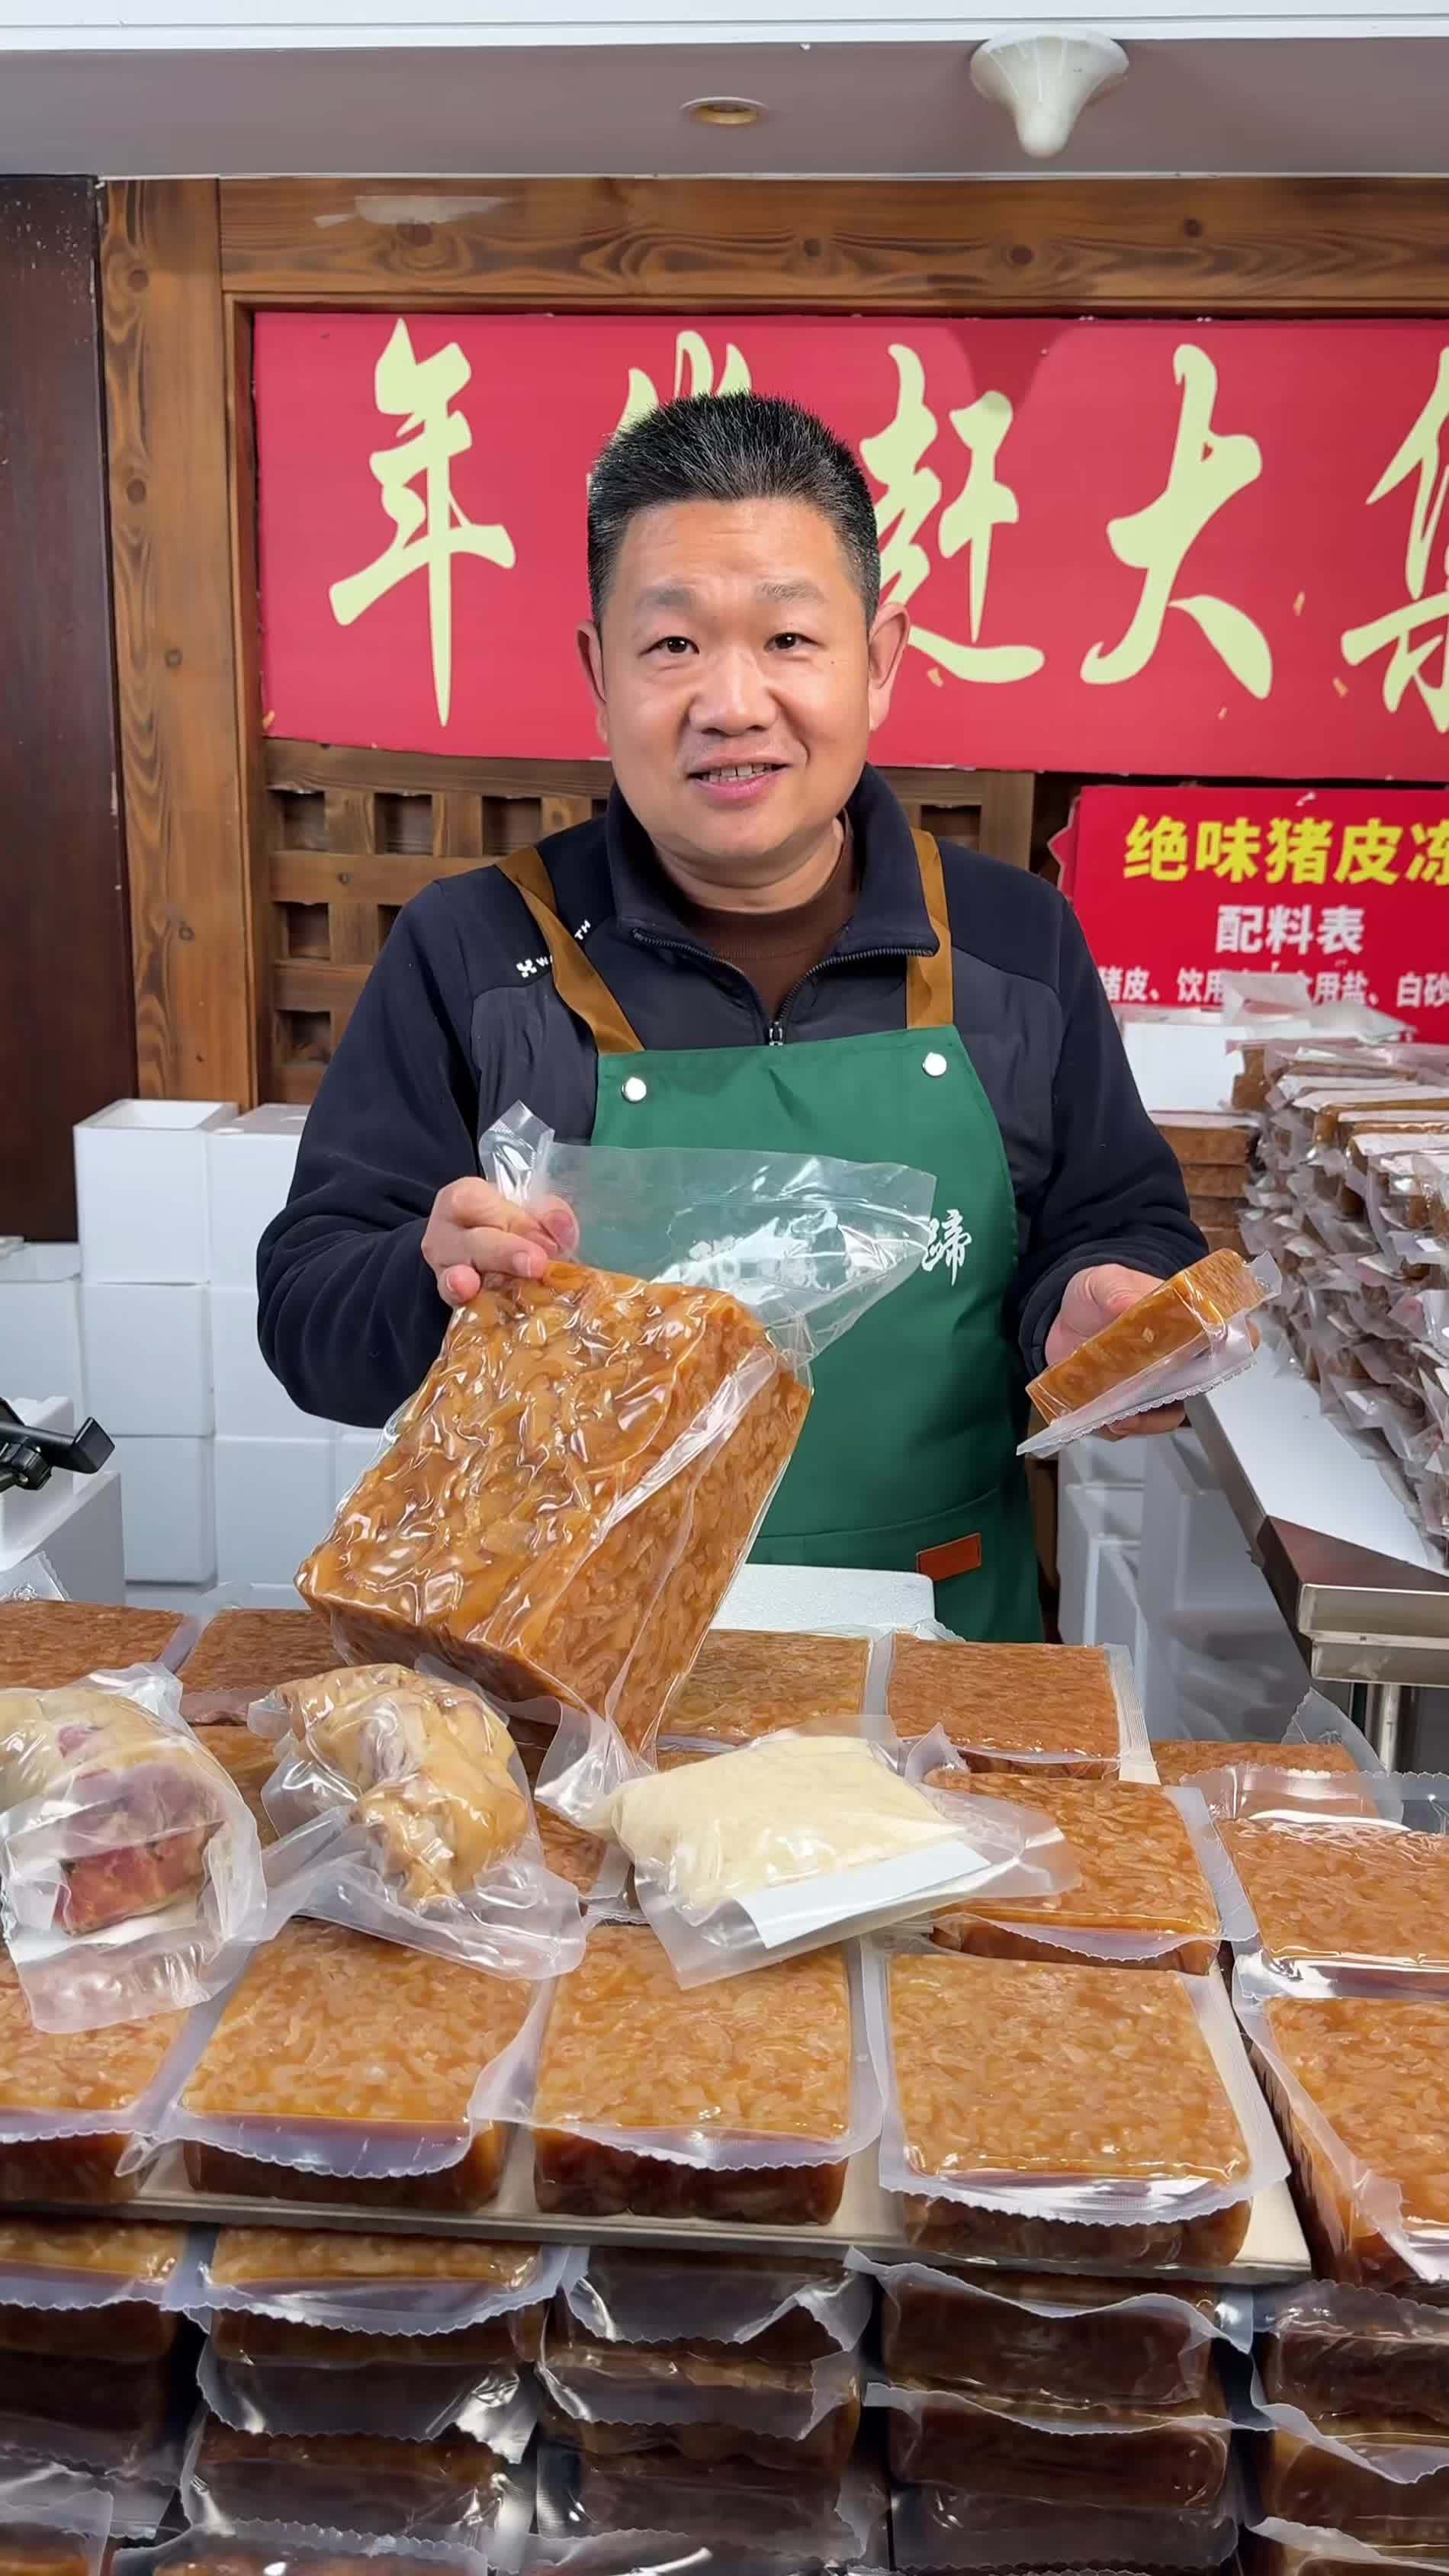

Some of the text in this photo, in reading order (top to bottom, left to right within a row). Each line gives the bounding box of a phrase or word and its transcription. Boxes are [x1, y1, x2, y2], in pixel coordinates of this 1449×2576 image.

[1123, 815, 1449, 885] 绝味猪皮冻
[1216, 905, 1365, 955] 配料表
